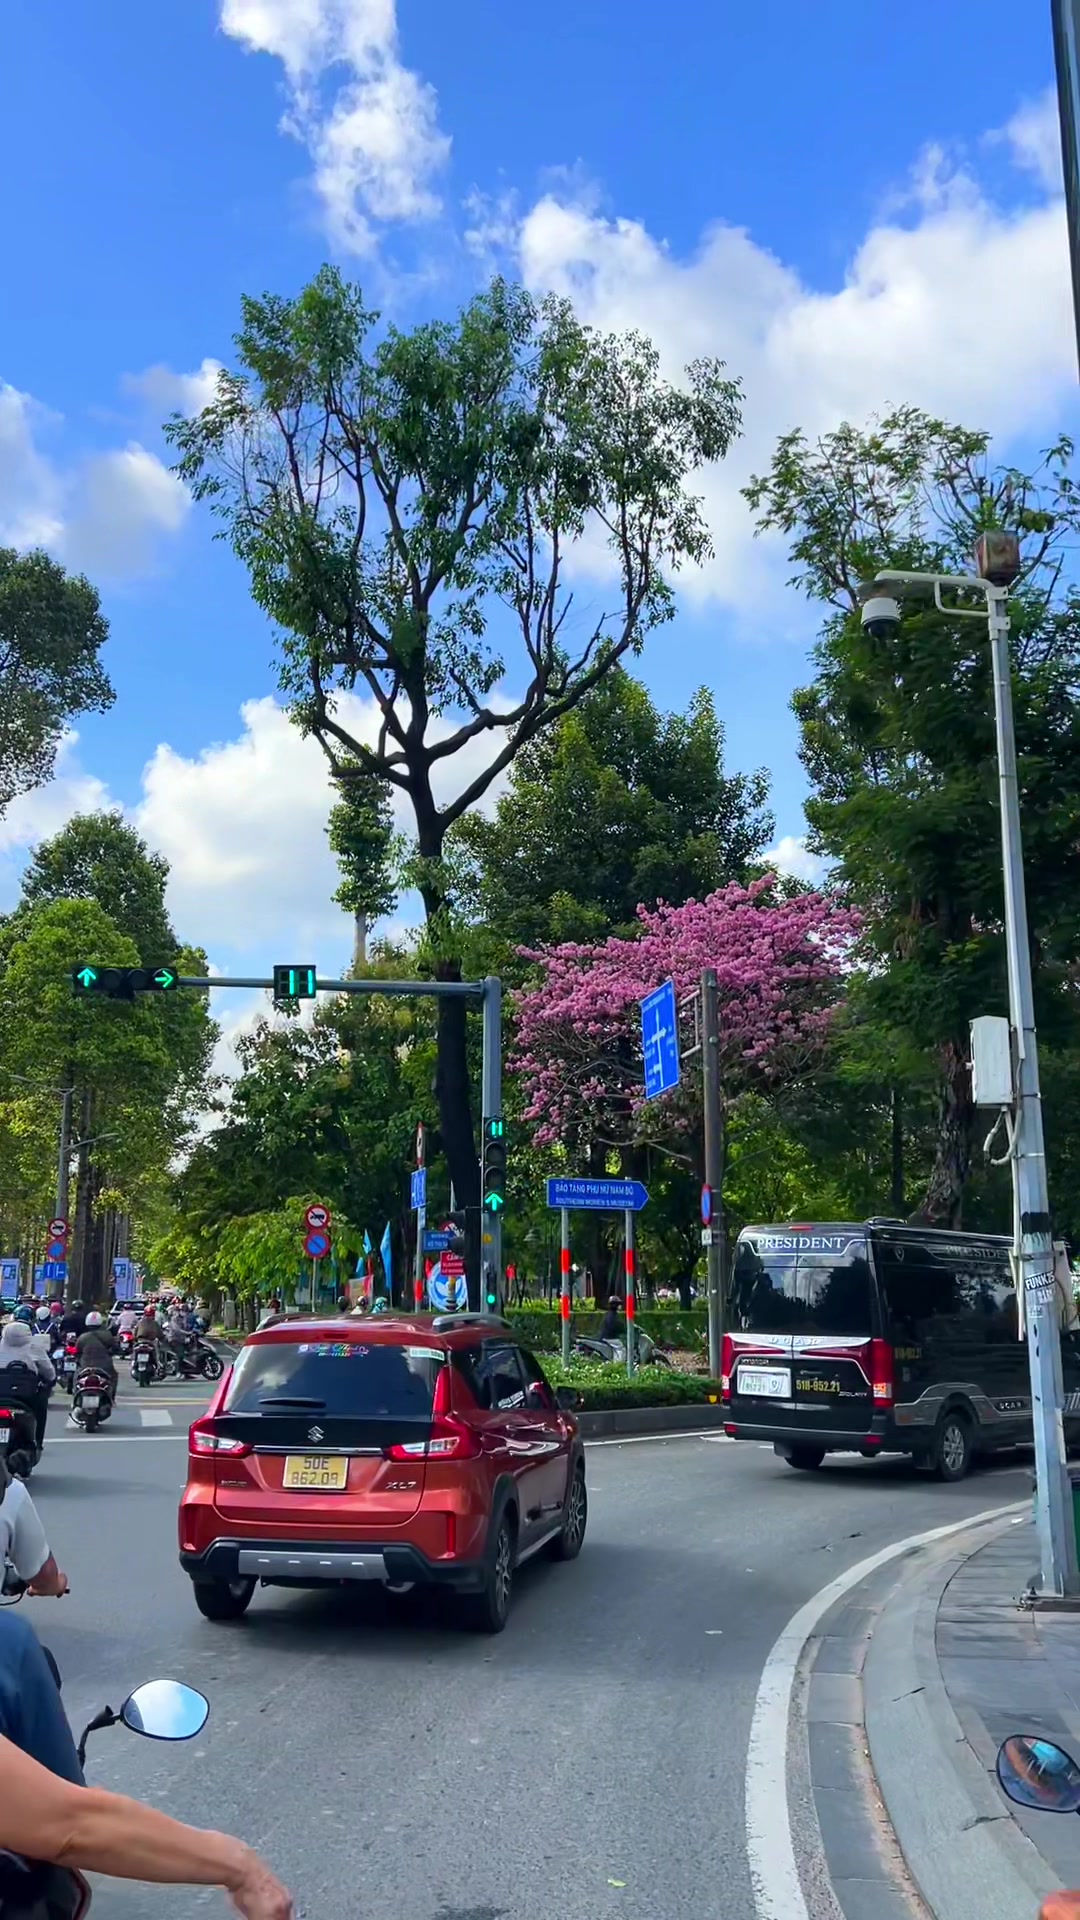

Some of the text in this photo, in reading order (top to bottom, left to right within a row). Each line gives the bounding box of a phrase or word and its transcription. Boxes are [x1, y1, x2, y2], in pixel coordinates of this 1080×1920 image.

[289, 969, 313, 995] 11
[756, 1237, 845, 1249] PRESIDENT
[303, 1456, 330, 1470] 50E
[291, 1471, 339, 1486] 862.09
